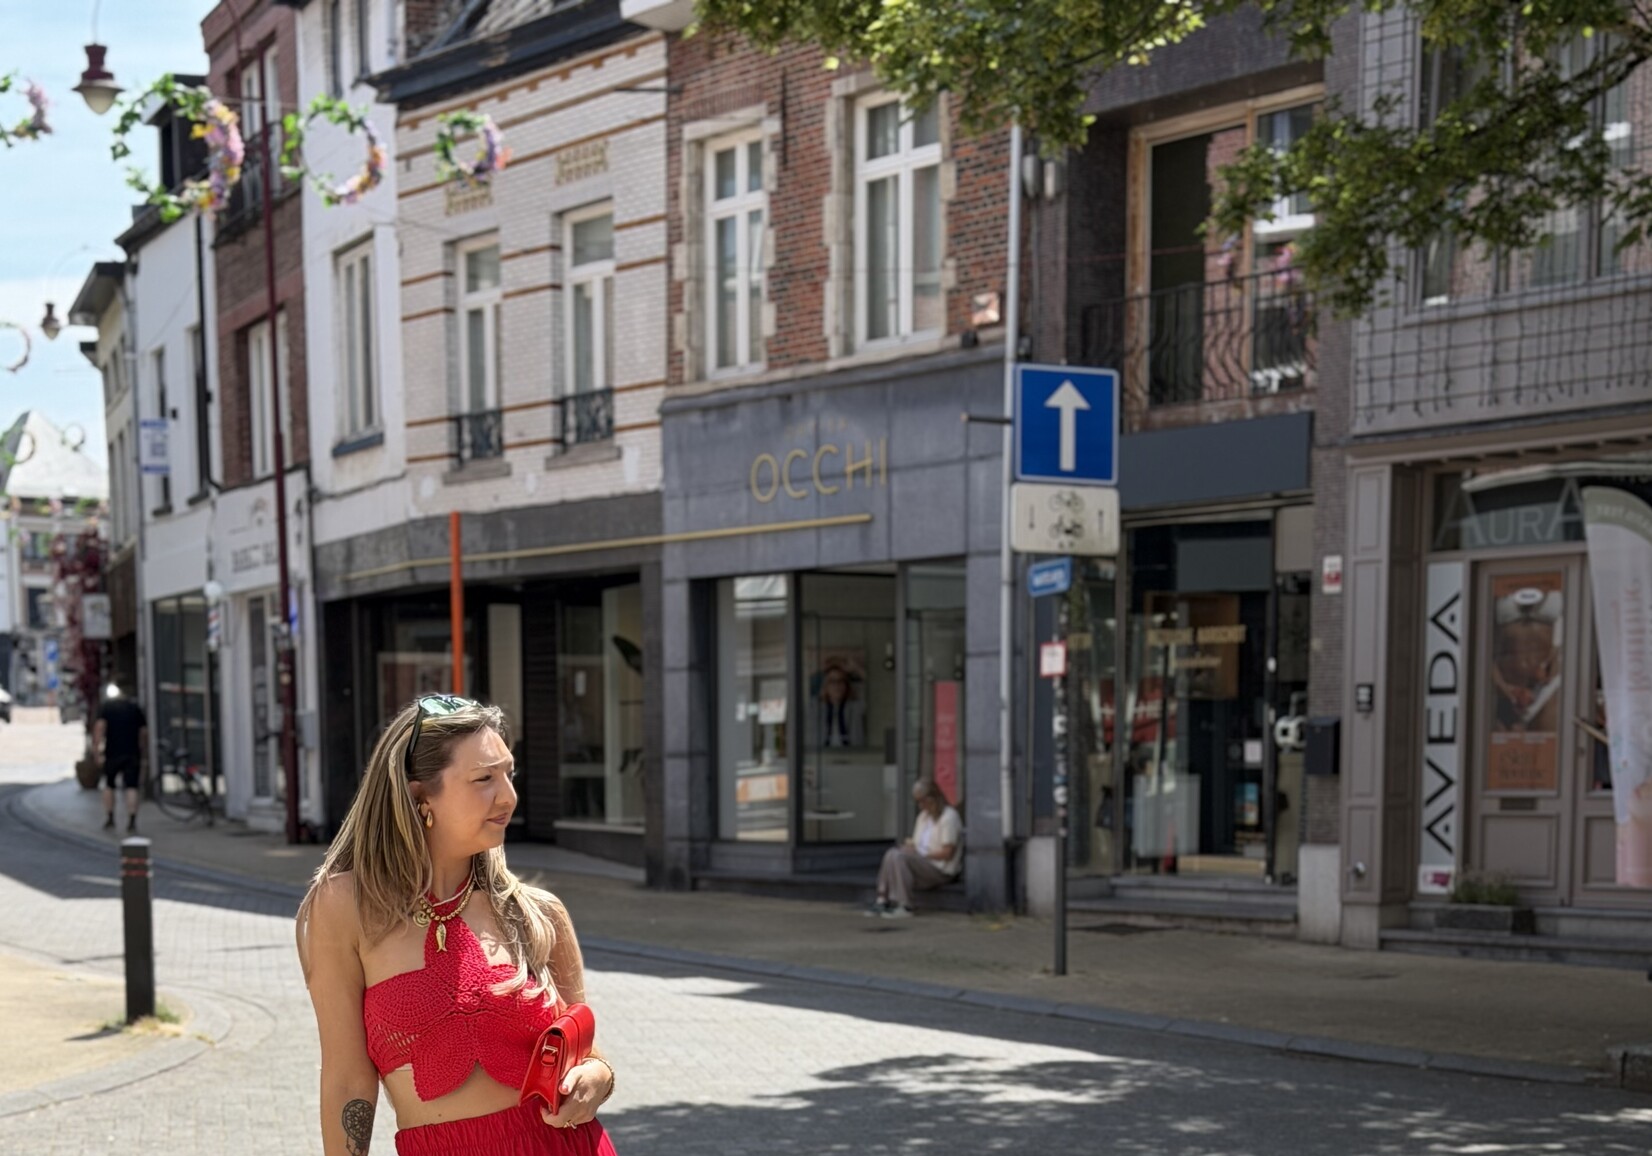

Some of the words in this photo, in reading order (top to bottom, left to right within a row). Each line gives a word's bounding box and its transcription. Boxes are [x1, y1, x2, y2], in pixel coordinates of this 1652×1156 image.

[751, 437, 888, 502] OCCHI
[1433, 475, 1585, 549] AURA
[1423, 591, 1461, 855] AVEDA
